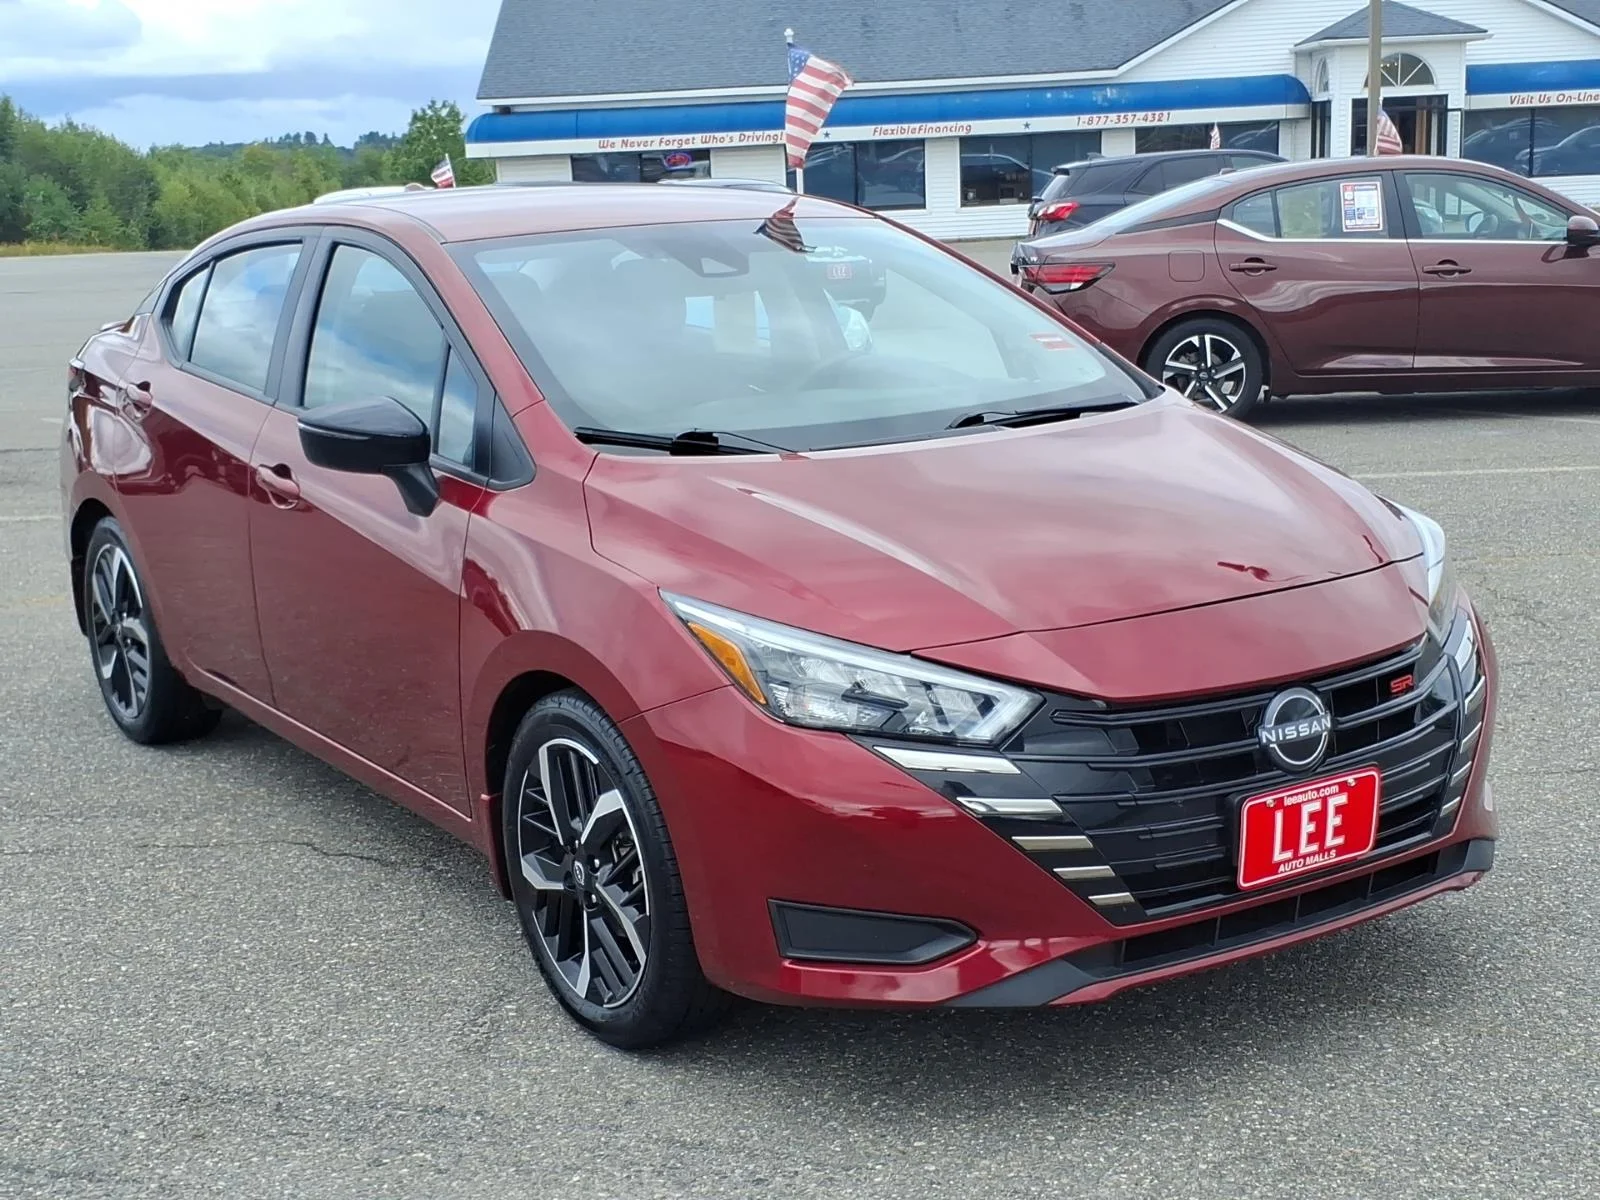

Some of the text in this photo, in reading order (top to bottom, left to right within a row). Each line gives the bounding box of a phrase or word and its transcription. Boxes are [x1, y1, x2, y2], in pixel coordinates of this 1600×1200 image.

[1509, 94, 1533, 105] Visit
[1539, 94, 1551, 104] Us
[1076, 112, 1171, 127] 1-877-357-4321
[872, 123, 972, 137] FlexibleFinancing
[598, 131, 783, 149] We Never Forget Who's Driving!
[1391, 675, 1414, 693] SR
[1262, 716, 1331, 743] NISSAN
[1284, 785, 1339, 806] leeauto.com
[1272, 793, 1348, 863] LEE
[1278, 849, 1337, 873] AUTO MALLS
